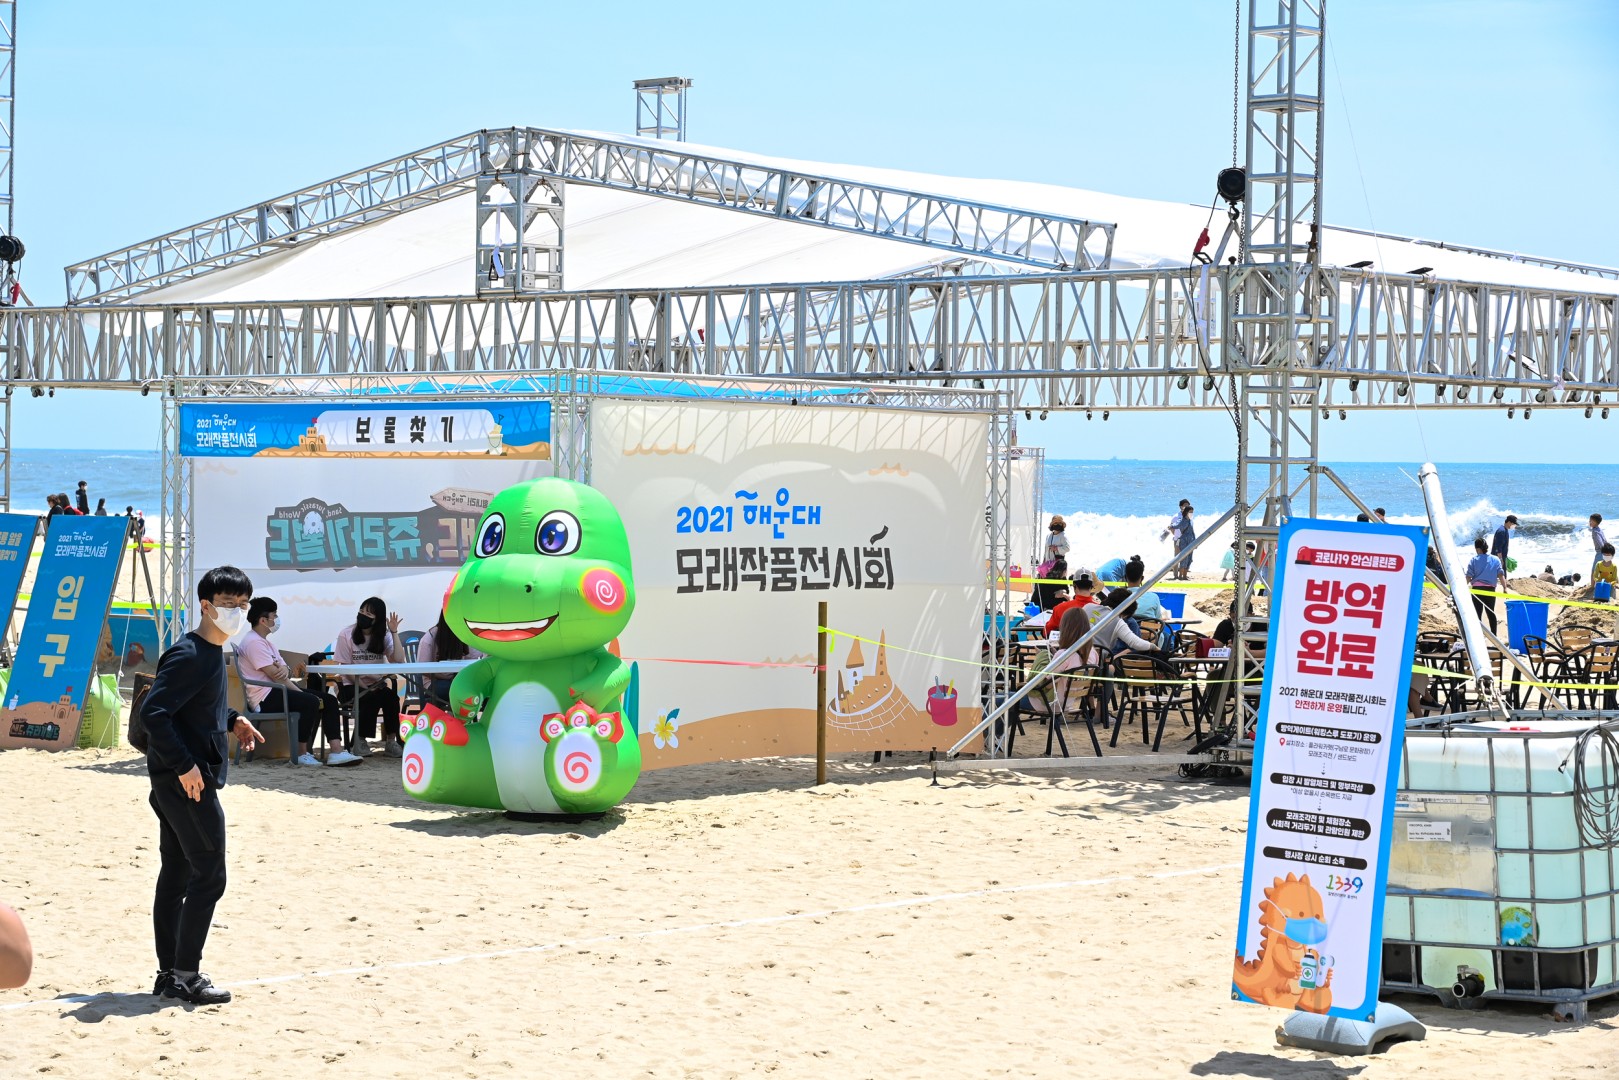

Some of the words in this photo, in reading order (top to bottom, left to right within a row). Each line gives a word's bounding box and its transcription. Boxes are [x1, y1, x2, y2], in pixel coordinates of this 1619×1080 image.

[196, 419, 212, 428] 2021
[212, 414, 237, 431] 해운대
[196, 426, 257, 448] 모래작품전시회
[677, 506, 733, 534] 2021
[735, 487, 821, 539] 해운대
[58, 534, 73, 542] 2021
[73, 531, 94, 544] 해운대
[54, 541, 109, 558] 모래작품전시회
[676, 525, 894, 594] 모래작품전시회
[1314, 552, 1350, 565] 코로나19
[1350, 554, 1398, 570] 안심클린존
[1303, 579, 1387, 629] 방역
[1296, 630, 1376, 680] 완료
[1279, 686, 1298, 696] 2021
[1300, 688, 1324, 700] 해운대
[1324, 691, 1387, 706] 모래작품전시회는
[1294, 700, 1326, 712] 안전하게
[1326, 703, 1368, 716] 운영됩니다.
[1286, 740, 1306, 748] 설치장소
[1340, 731, 1362, 740] 도포기)
[1363, 733, 1377, 742] 운영
[1308, 751, 1333, 760] 모래조각전
[1282, 775, 1296, 784] 입장
[1296, 777, 1302, 785] 시
[1304, 778, 1328, 788] 발열체크
[1330, 781, 1337, 789] 및
[1338, 782, 1364, 792] 명부작성
[1286, 812, 1318, 823] 모래조각전
[1318, 816, 1325, 824] 및
[1326, 817, 1352, 827] 체험장소
[1272, 820, 1290, 828] 사회적
[1291, 822, 1316, 832] 거리두기
[1317, 825, 1324, 834] 및
[1325, 826, 1350, 836] 관람인원
[1351, 830, 1365, 838] 제한
[1284, 850, 1304, 860] 행사장
[1304, 852, 1318, 862] 상시
[1318, 854, 1332, 864] 순회
[1332, 856, 1346, 866] 소독
[1326, 874, 1364, 894] 1339
